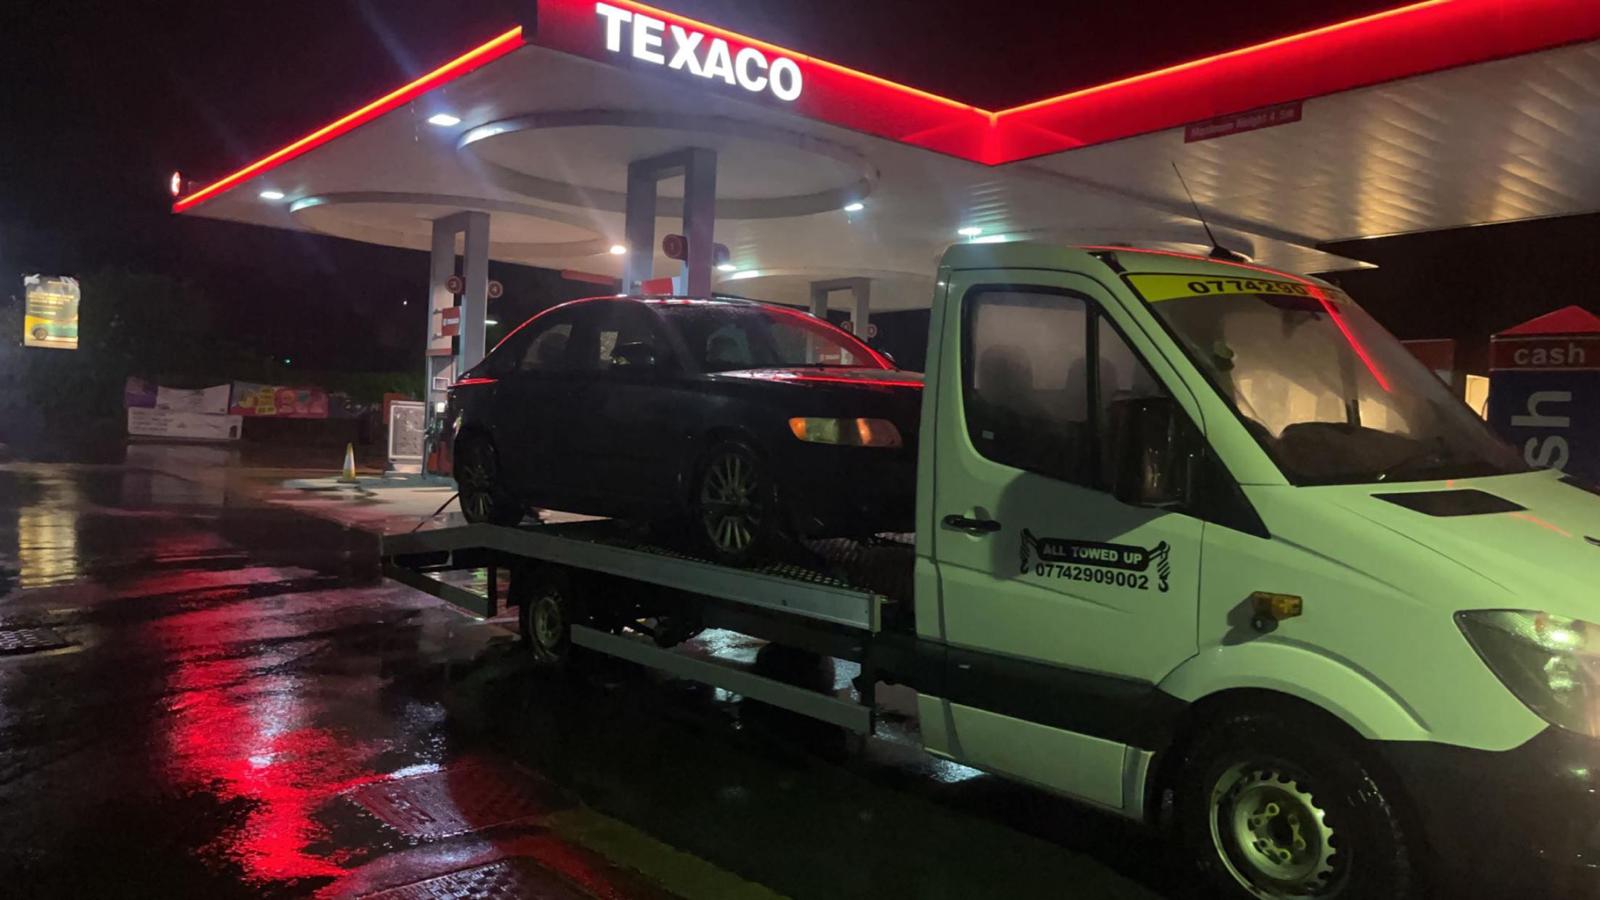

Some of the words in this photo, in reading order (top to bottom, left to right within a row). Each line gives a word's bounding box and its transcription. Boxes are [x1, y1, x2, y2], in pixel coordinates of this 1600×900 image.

[596, 2, 803, 101] TEXACO
[1187, 279, 1312, 295] 0774290
[1513, 342, 1585, 365] cash
[1511, 391, 1572, 471] sh
[1042, 545, 1067, 556] ALL
[1072, 546, 1119, 561] TOWED
[1123, 552, 1143, 565] UP
[1035, 563, 1149, 590] 07742909002
